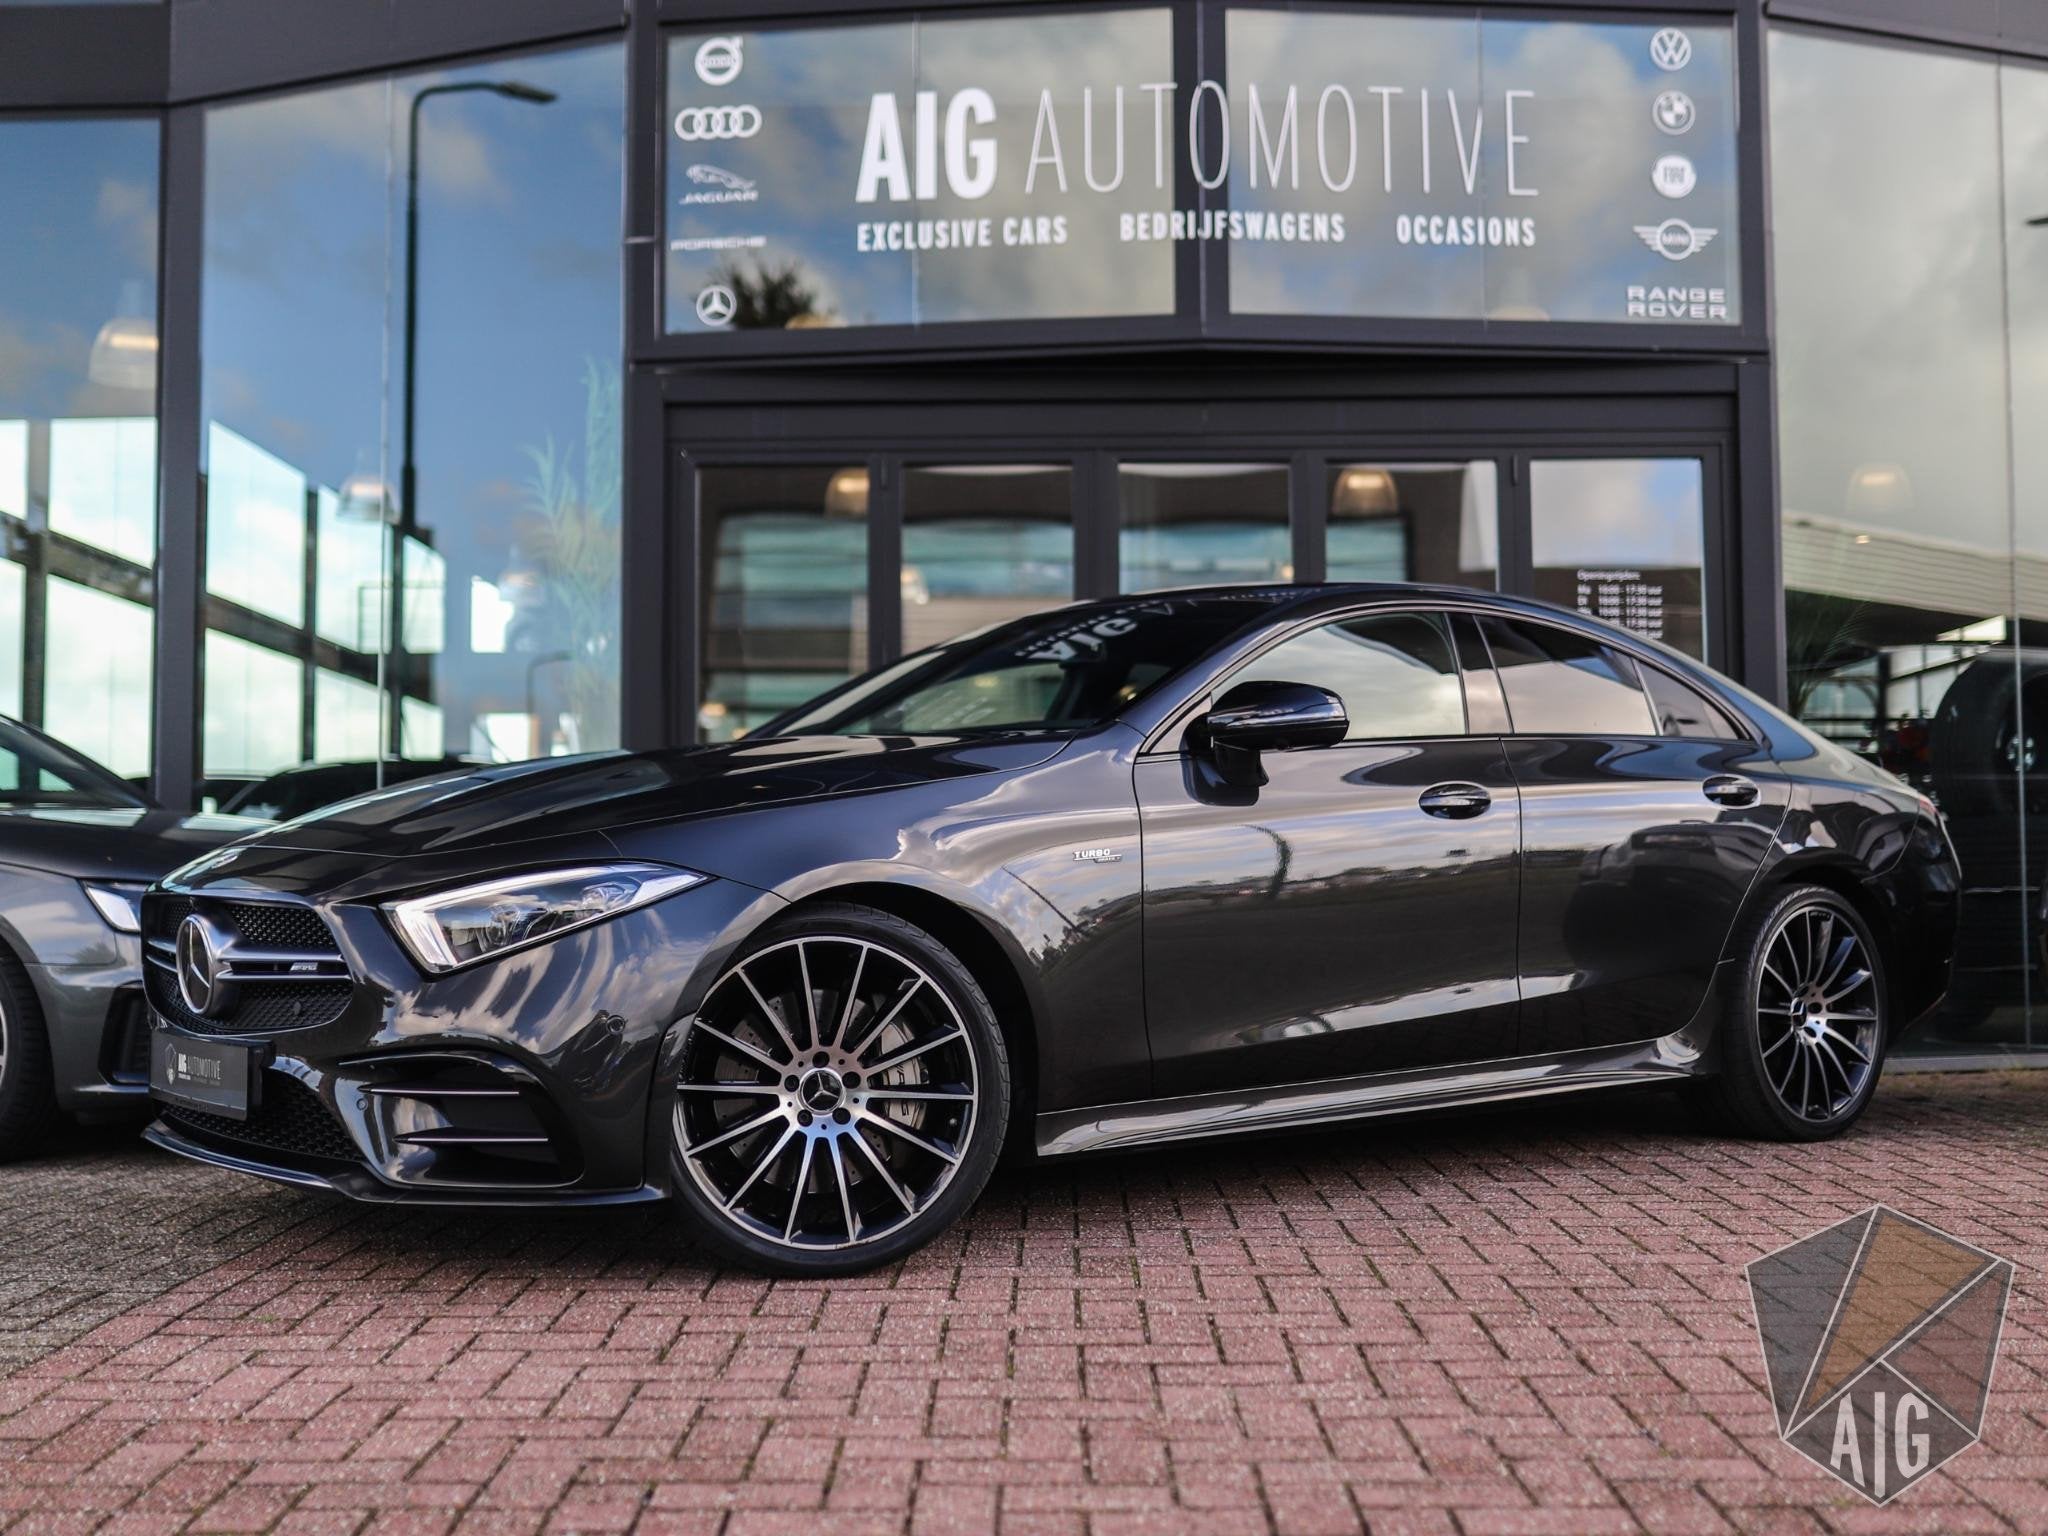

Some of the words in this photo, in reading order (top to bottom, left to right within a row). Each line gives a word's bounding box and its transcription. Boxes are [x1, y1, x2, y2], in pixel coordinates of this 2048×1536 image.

[855, 88, 999, 203] AIG
[1024, 80, 1540, 197] AUTOMOTIVE
[856, 219, 993, 252] EXCLUSIVE
[1003, 216, 1069, 247] CARS
[1120, 210, 1346, 243] BEDRIJFSWAGENS
[1395, 215, 1537, 247] OCCASIONS
[1627, 286, 1725, 303] RANGE
[1627, 301, 1726, 319] ROVER
[1074, 849, 1111, 859] TURBO
